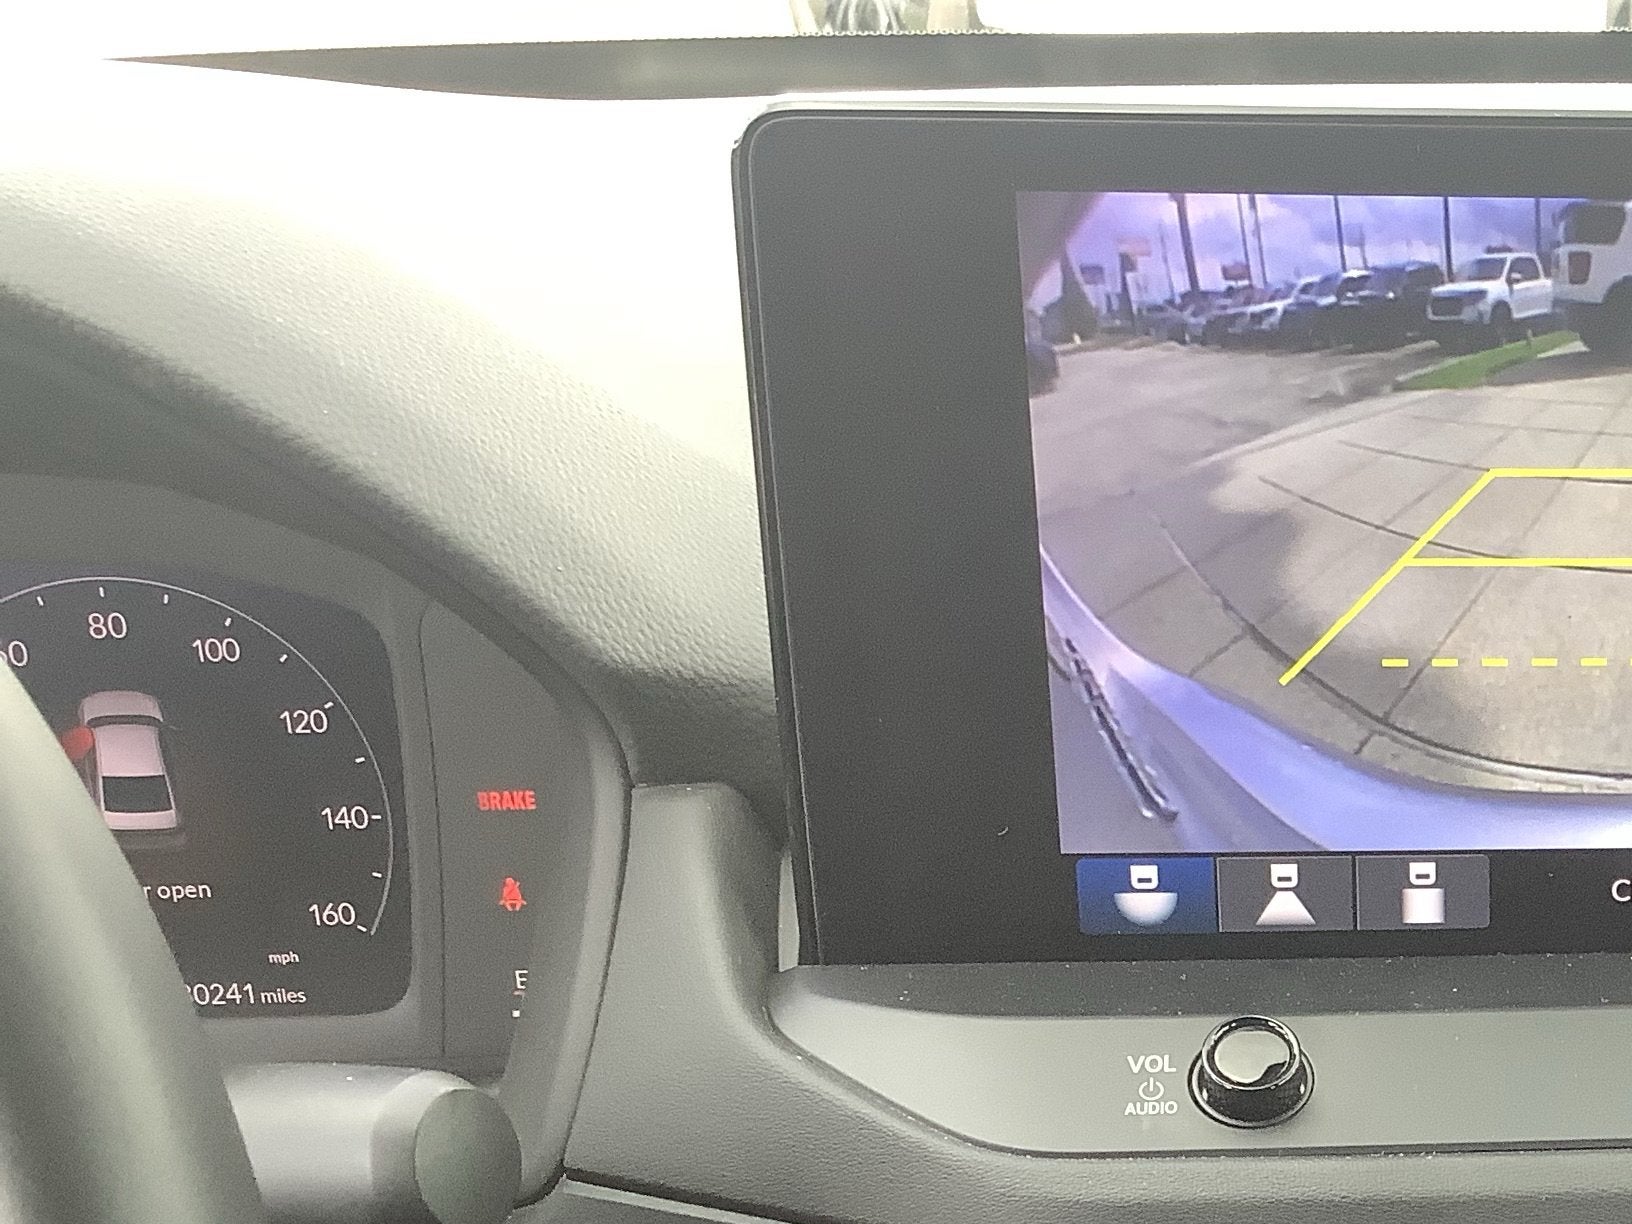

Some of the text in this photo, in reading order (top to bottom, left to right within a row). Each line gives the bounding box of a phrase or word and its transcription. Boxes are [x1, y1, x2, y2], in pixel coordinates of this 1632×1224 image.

[87, 612, 128, 639] 80
[192, 637, 241, 663] 100
[279, 708, 328, 734] 120
[477, 790, 536, 811] BRAKE
[321, 805, 368, 829] 140
[157, 884, 212, 902] open
[309, 902, 356, 926] 160
[268, 951, 300, 965] mph
[515, 970, 528, 989] E
[185, 983, 307, 1006] 0241 miles
[1126, 1054, 1177, 1074] VOL
[1124, 1101, 1178, 1116] AUDIO
